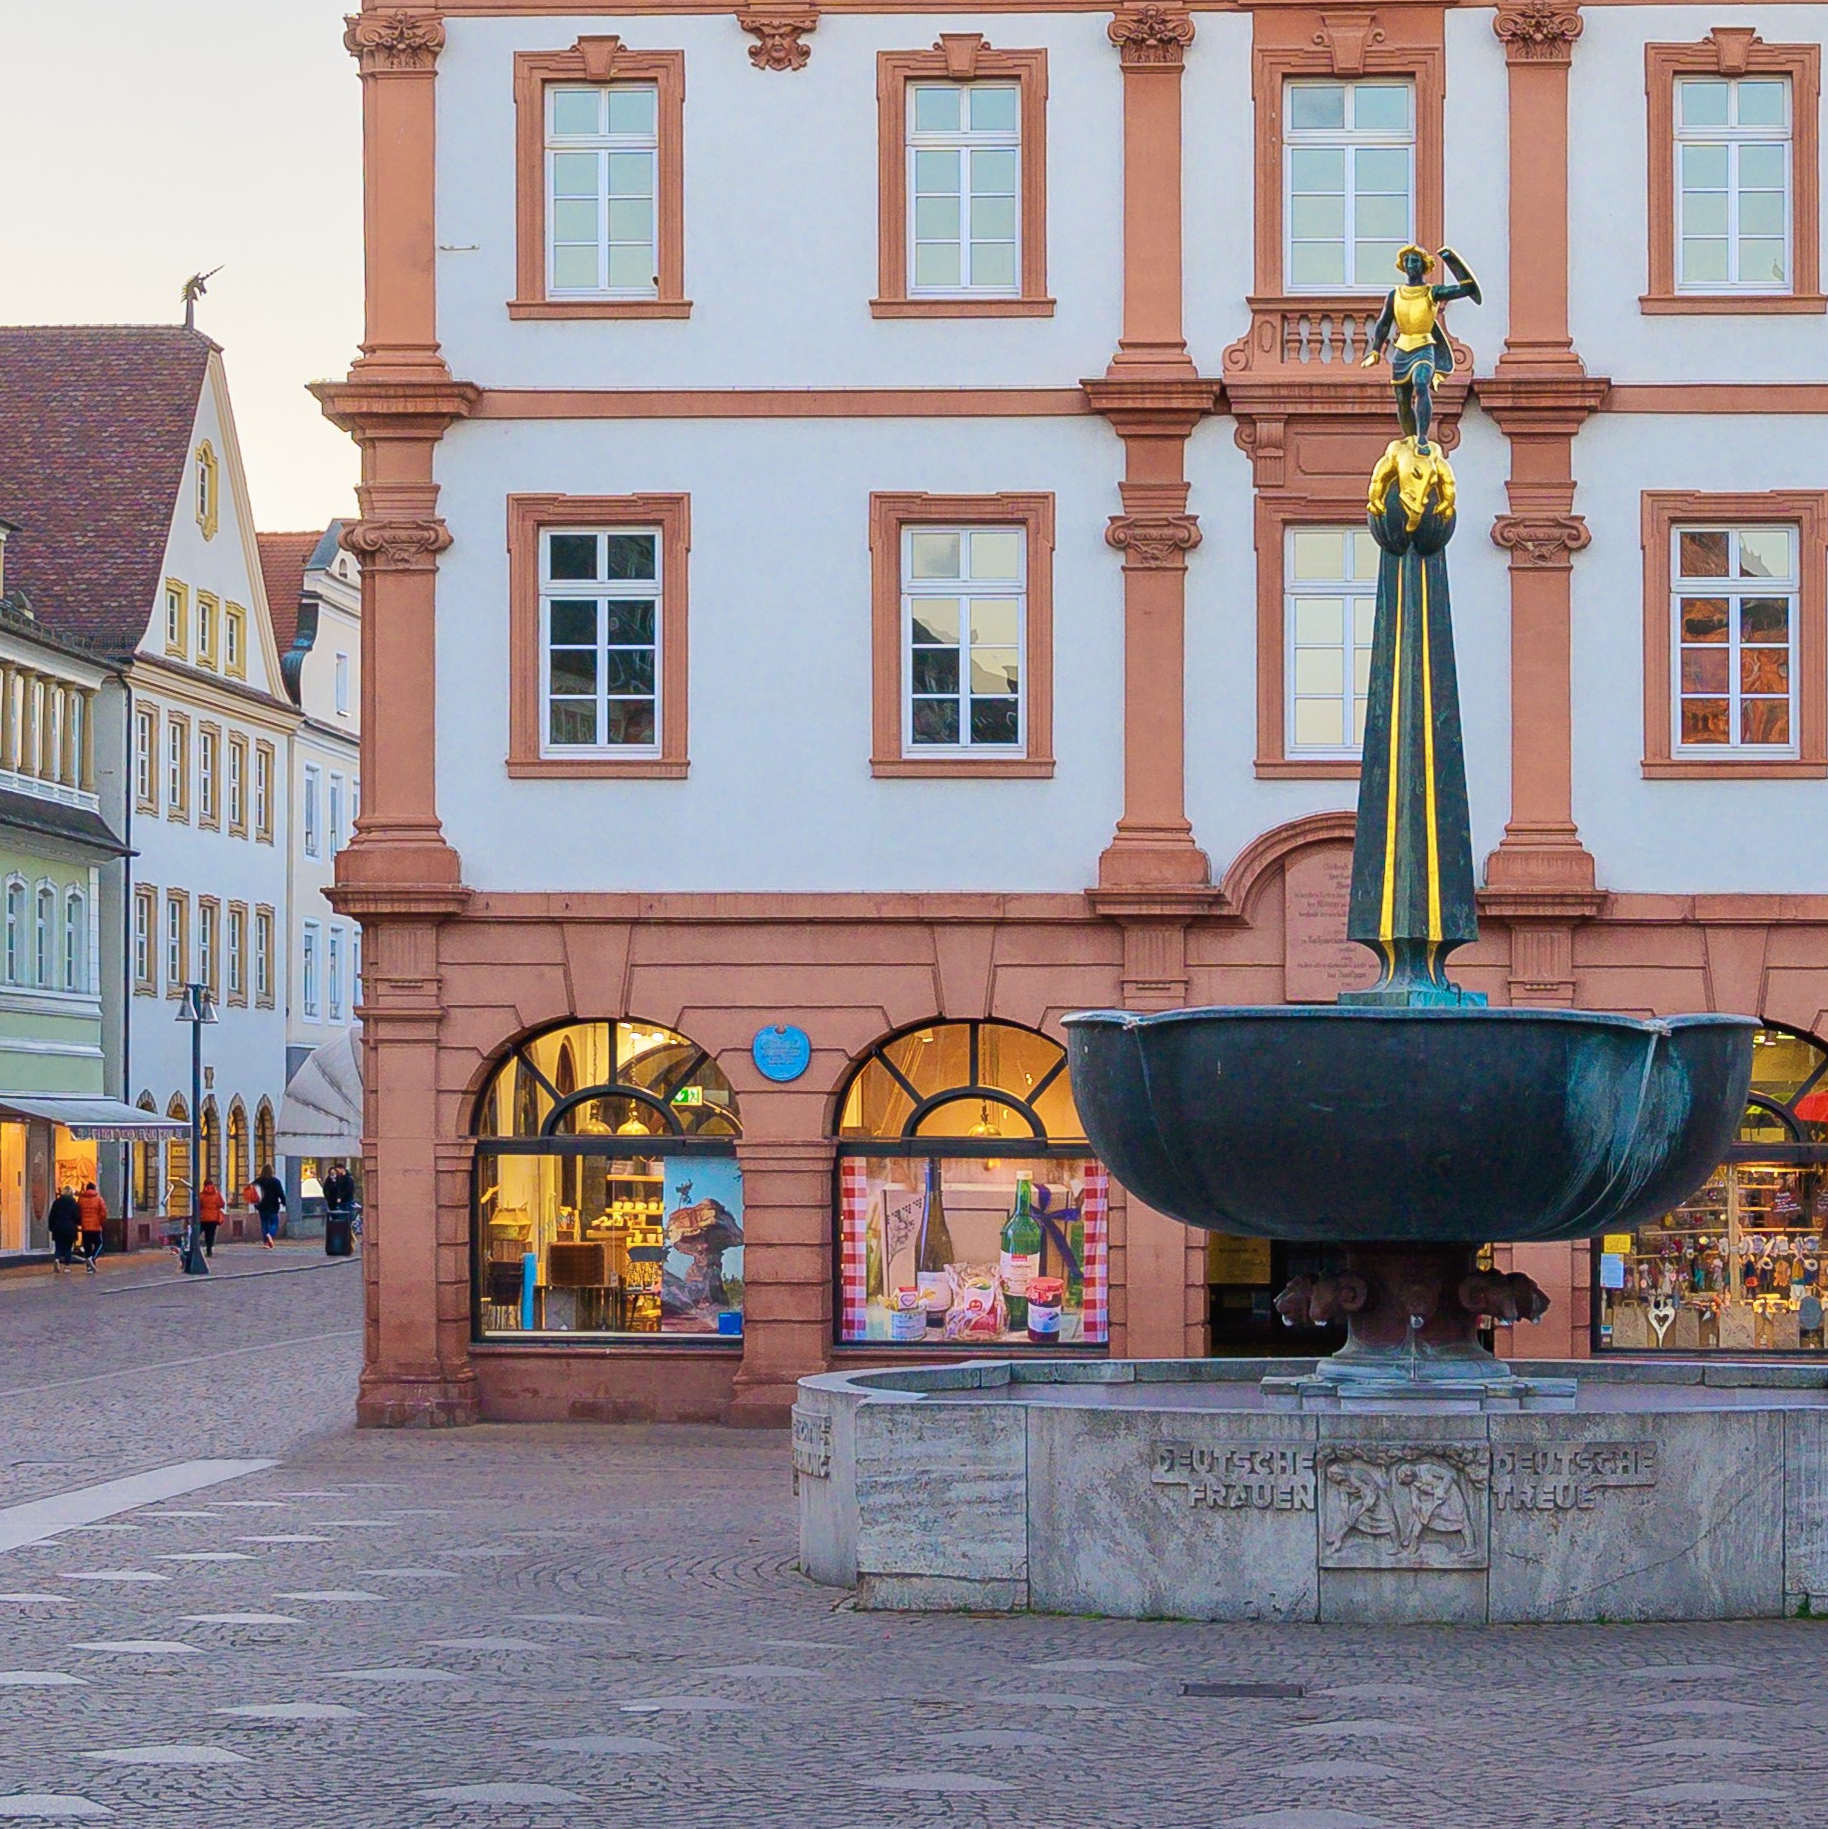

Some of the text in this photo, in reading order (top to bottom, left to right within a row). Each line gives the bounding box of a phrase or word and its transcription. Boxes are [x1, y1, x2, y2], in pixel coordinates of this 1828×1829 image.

[1158, 1447, 1315, 1475] DEUTSCHE
[1492, 1449, 1655, 1475] DEUTSCHE
[1187, 1483, 1316, 1510] FRAUEN
[1492, 1483, 1596, 1510] TREUE
